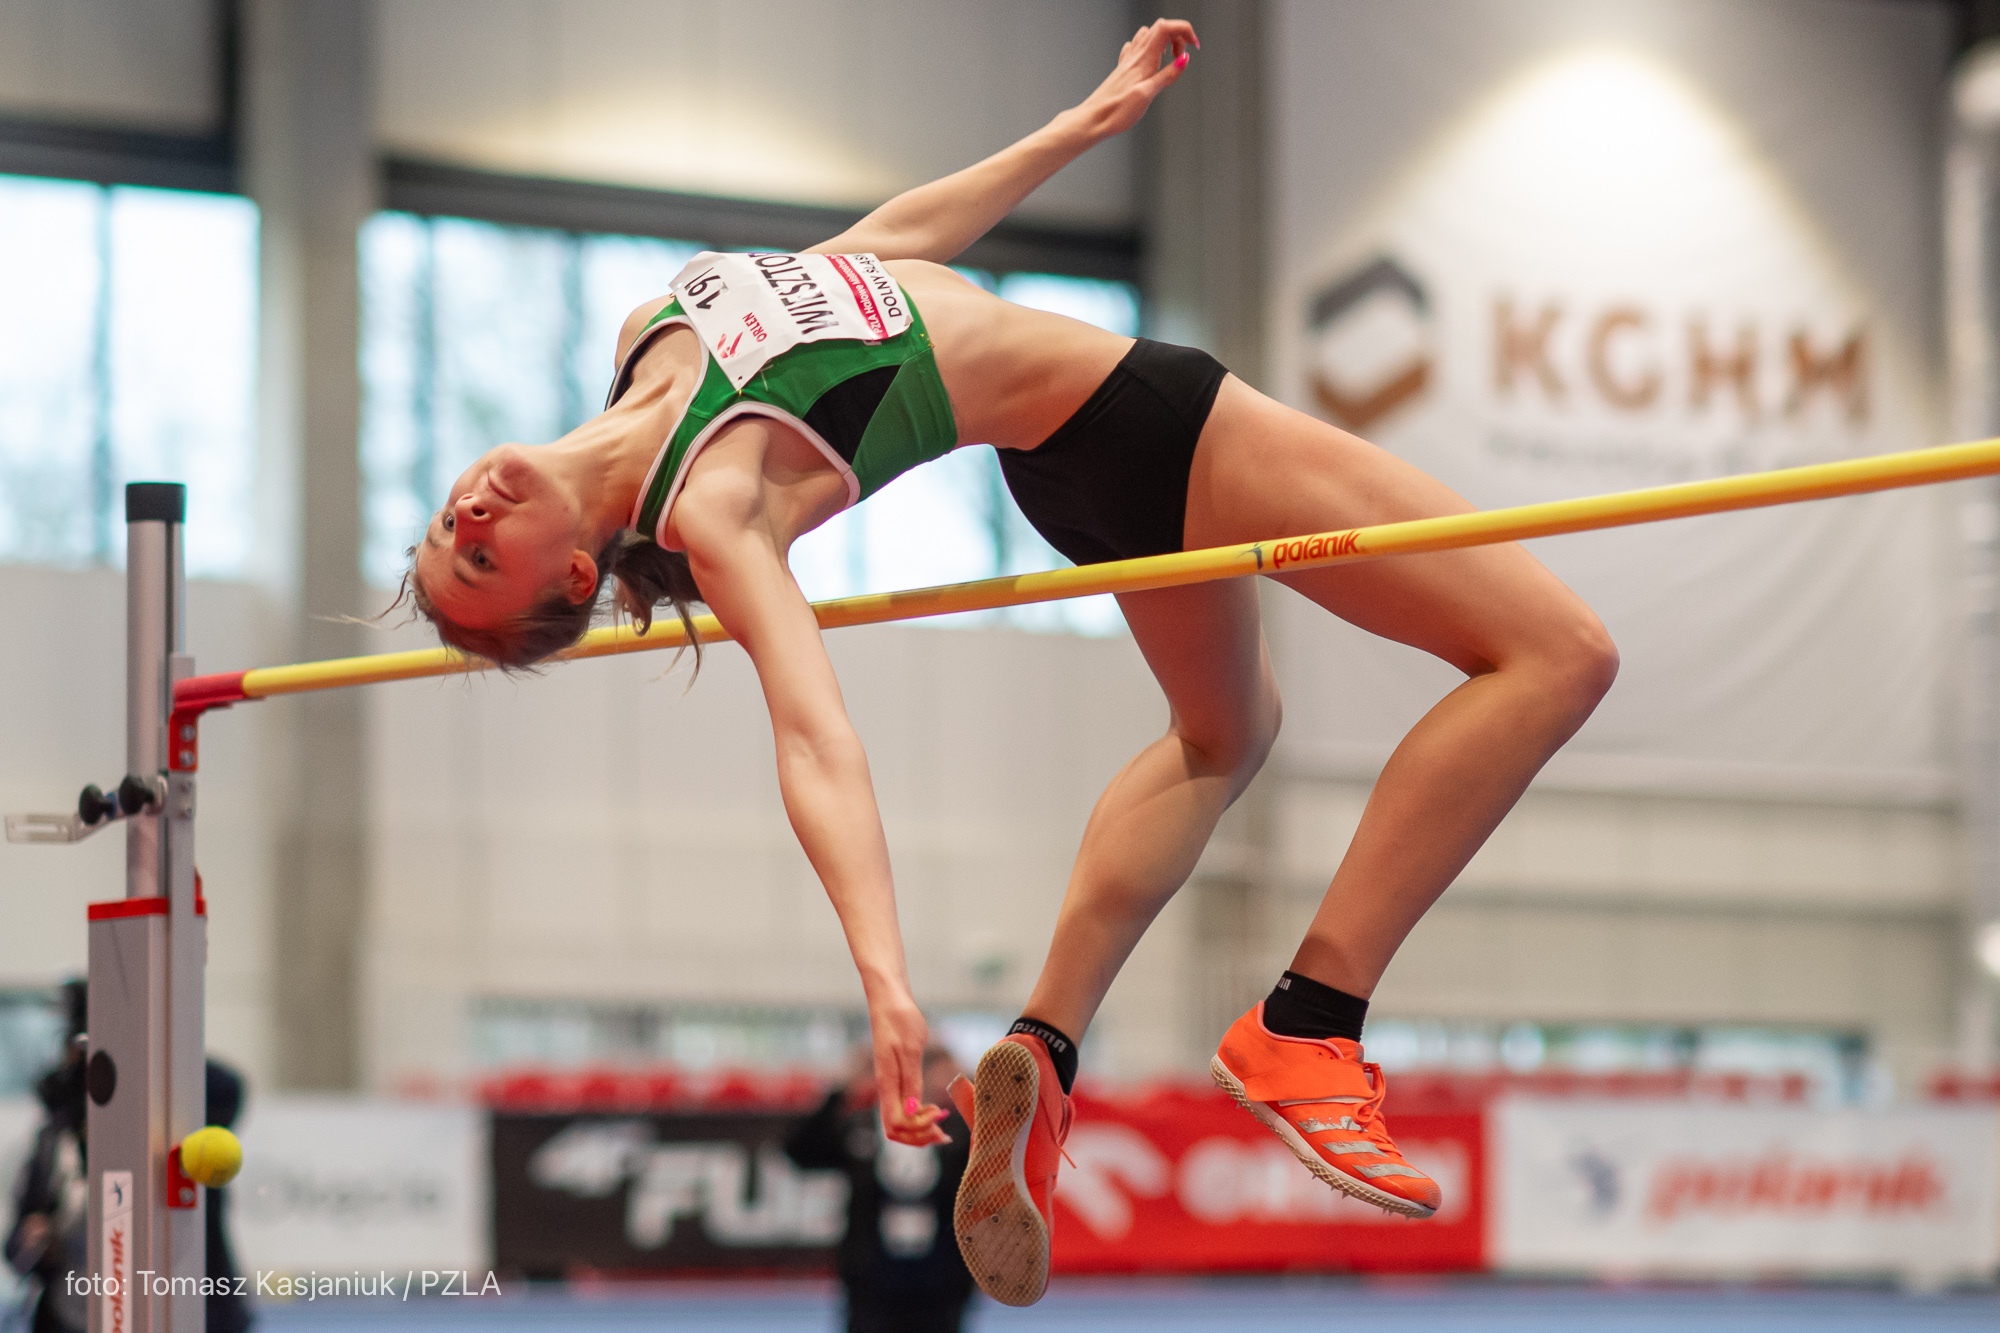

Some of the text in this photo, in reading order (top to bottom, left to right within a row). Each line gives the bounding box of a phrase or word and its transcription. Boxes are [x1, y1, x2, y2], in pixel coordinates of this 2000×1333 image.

[748, 253, 839, 335] WIESZTO
[855, 284, 876, 315] Halowe
[869, 276, 903, 318] DOLNY
[742, 312, 768, 342] ORLEN
[867, 313, 884, 334] PZLA
[1488, 290, 1872, 432] KGHM
[1273, 529, 1361, 569] polanik
